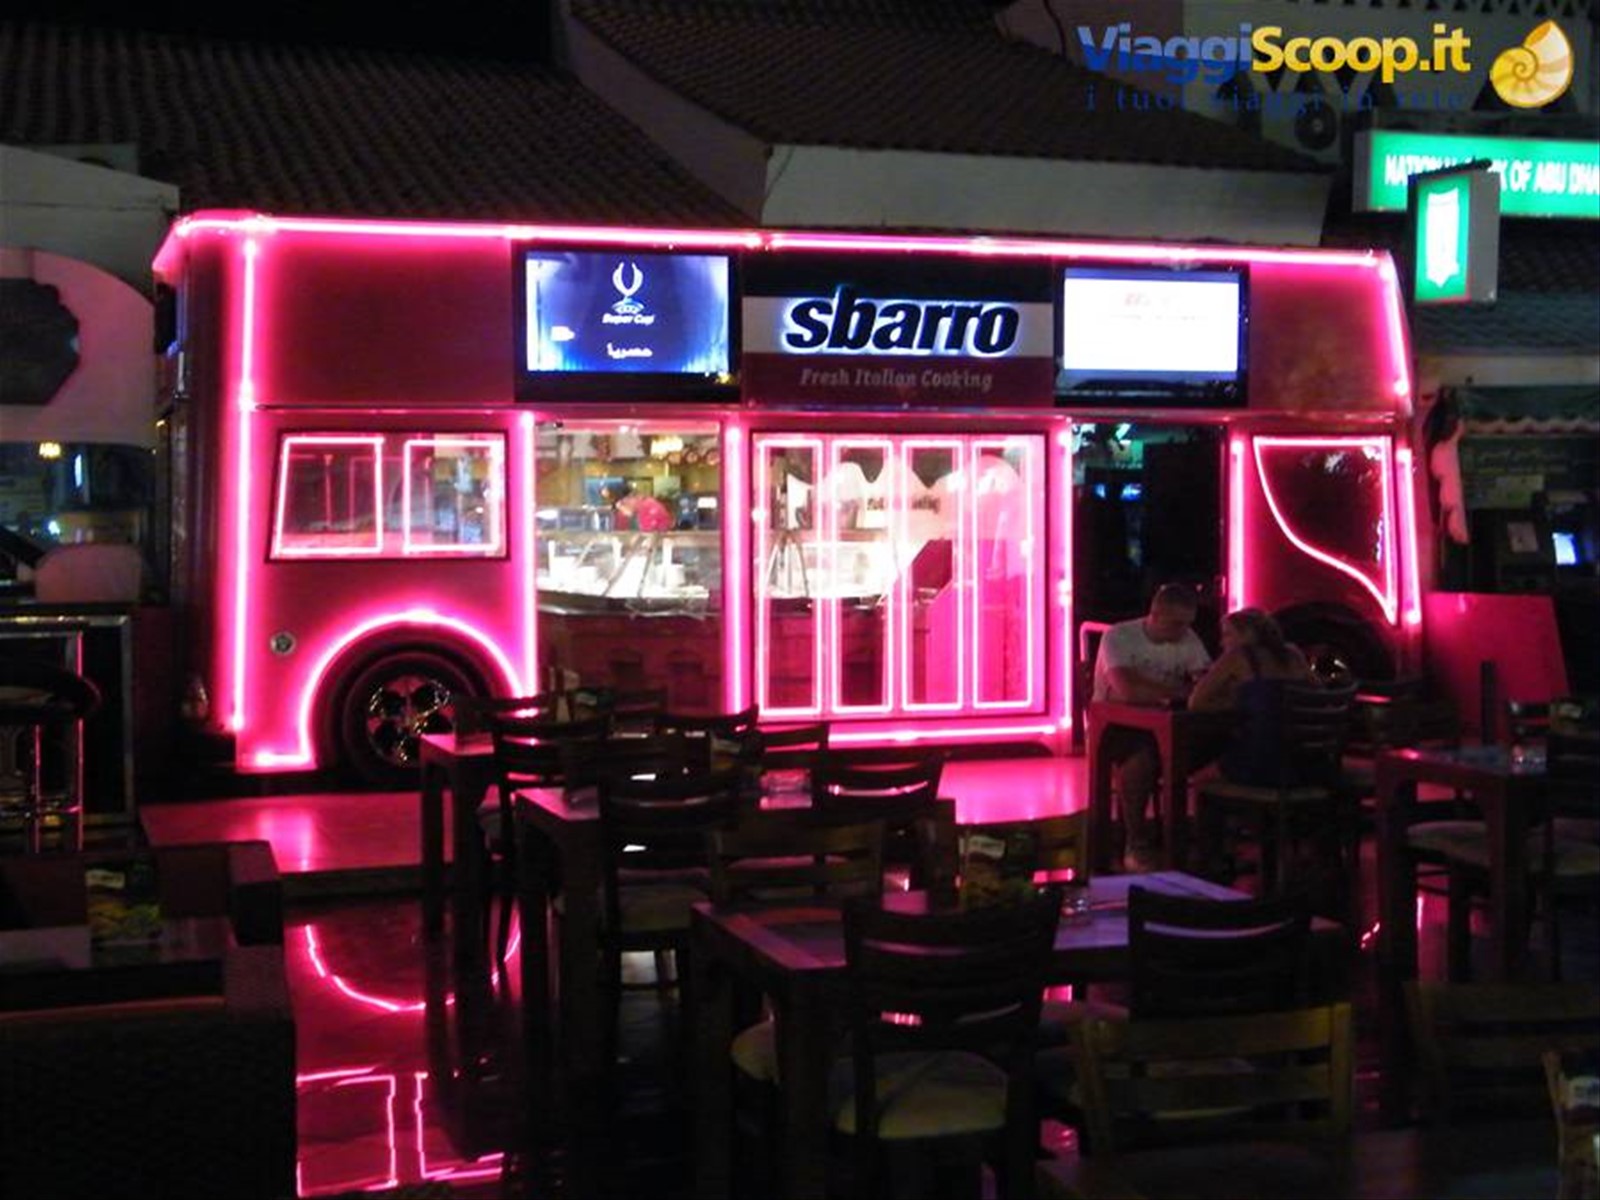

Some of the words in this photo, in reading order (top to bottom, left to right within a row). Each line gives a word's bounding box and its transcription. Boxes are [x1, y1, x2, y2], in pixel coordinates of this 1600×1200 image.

[1509, 159, 1532, 192] OF
[784, 286, 1020, 355] sbarro
[800, 368, 850, 387] Fresh
[854, 368, 917, 388] Italian
[920, 369, 993, 393] Cooking
